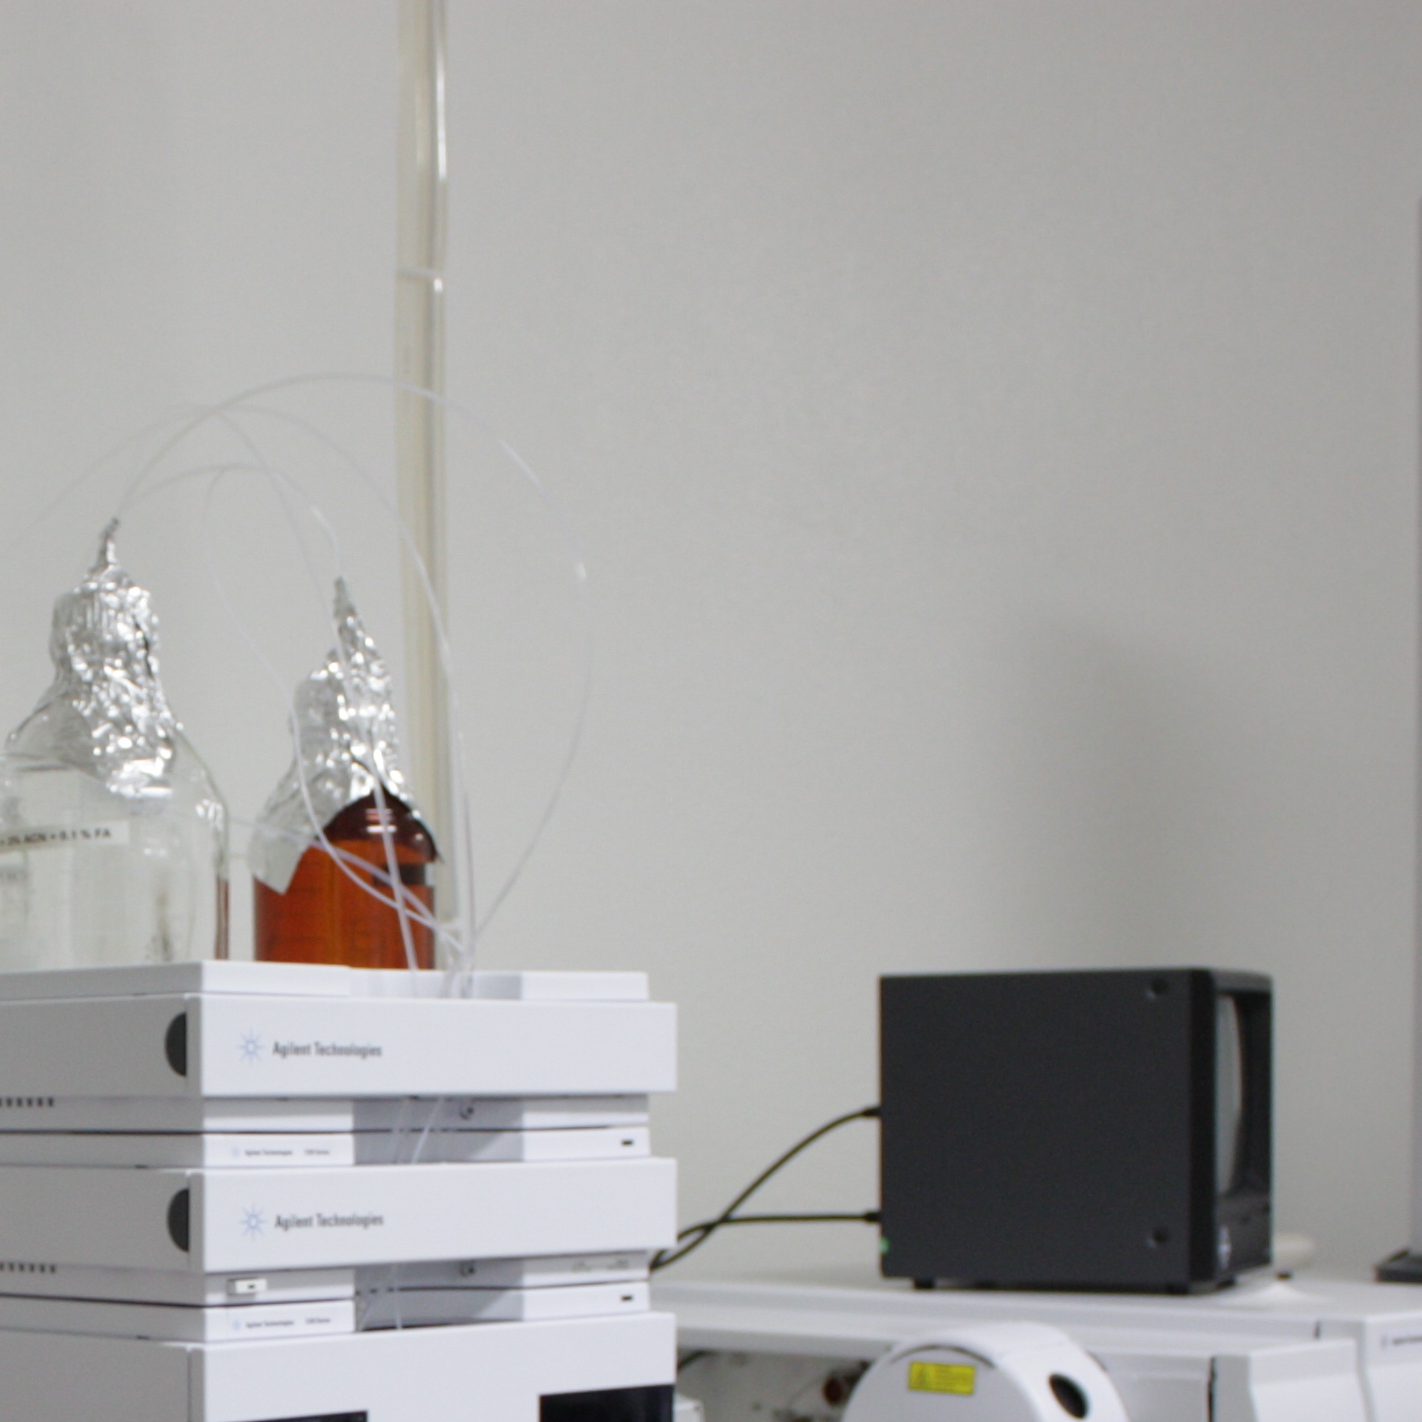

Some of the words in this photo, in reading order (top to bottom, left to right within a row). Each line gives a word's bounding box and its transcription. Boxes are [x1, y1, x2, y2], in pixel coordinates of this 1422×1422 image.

[272, 1041, 311, 1059] Agilent
[314, 1040, 382, 1059] Technologies
[274, 1213, 313, 1232] Agilent
[316, 1212, 384, 1230] Technologies
